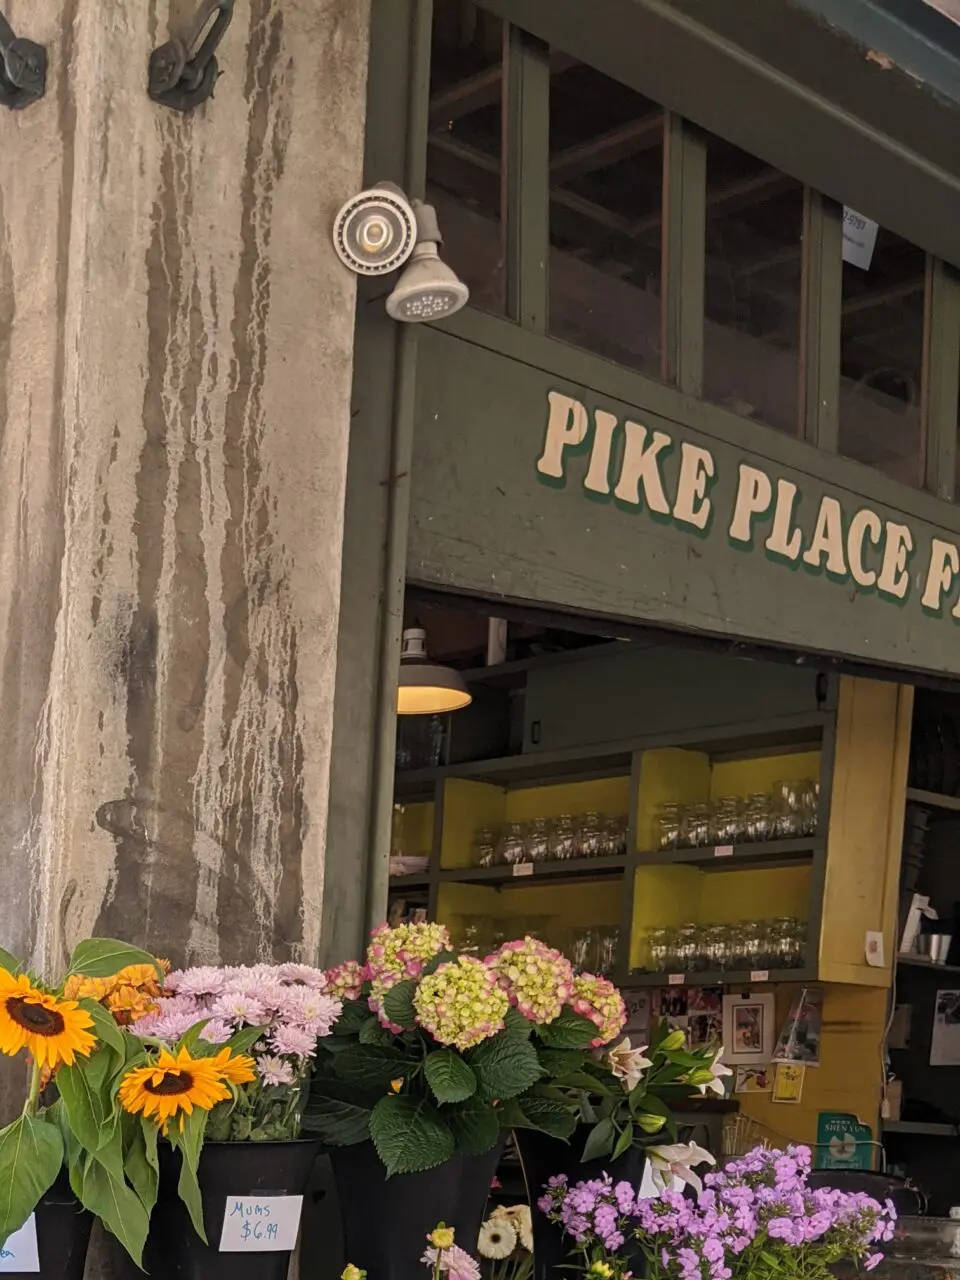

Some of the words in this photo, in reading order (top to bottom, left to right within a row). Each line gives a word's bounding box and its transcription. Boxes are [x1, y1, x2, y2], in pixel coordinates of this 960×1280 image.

[537, 391, 715, 530] PIKE
[729, 464, 913, 599] PLACE
[230, 1202, 271, 1217] Mums
[240, 1220, 279, 1242] $6.99
